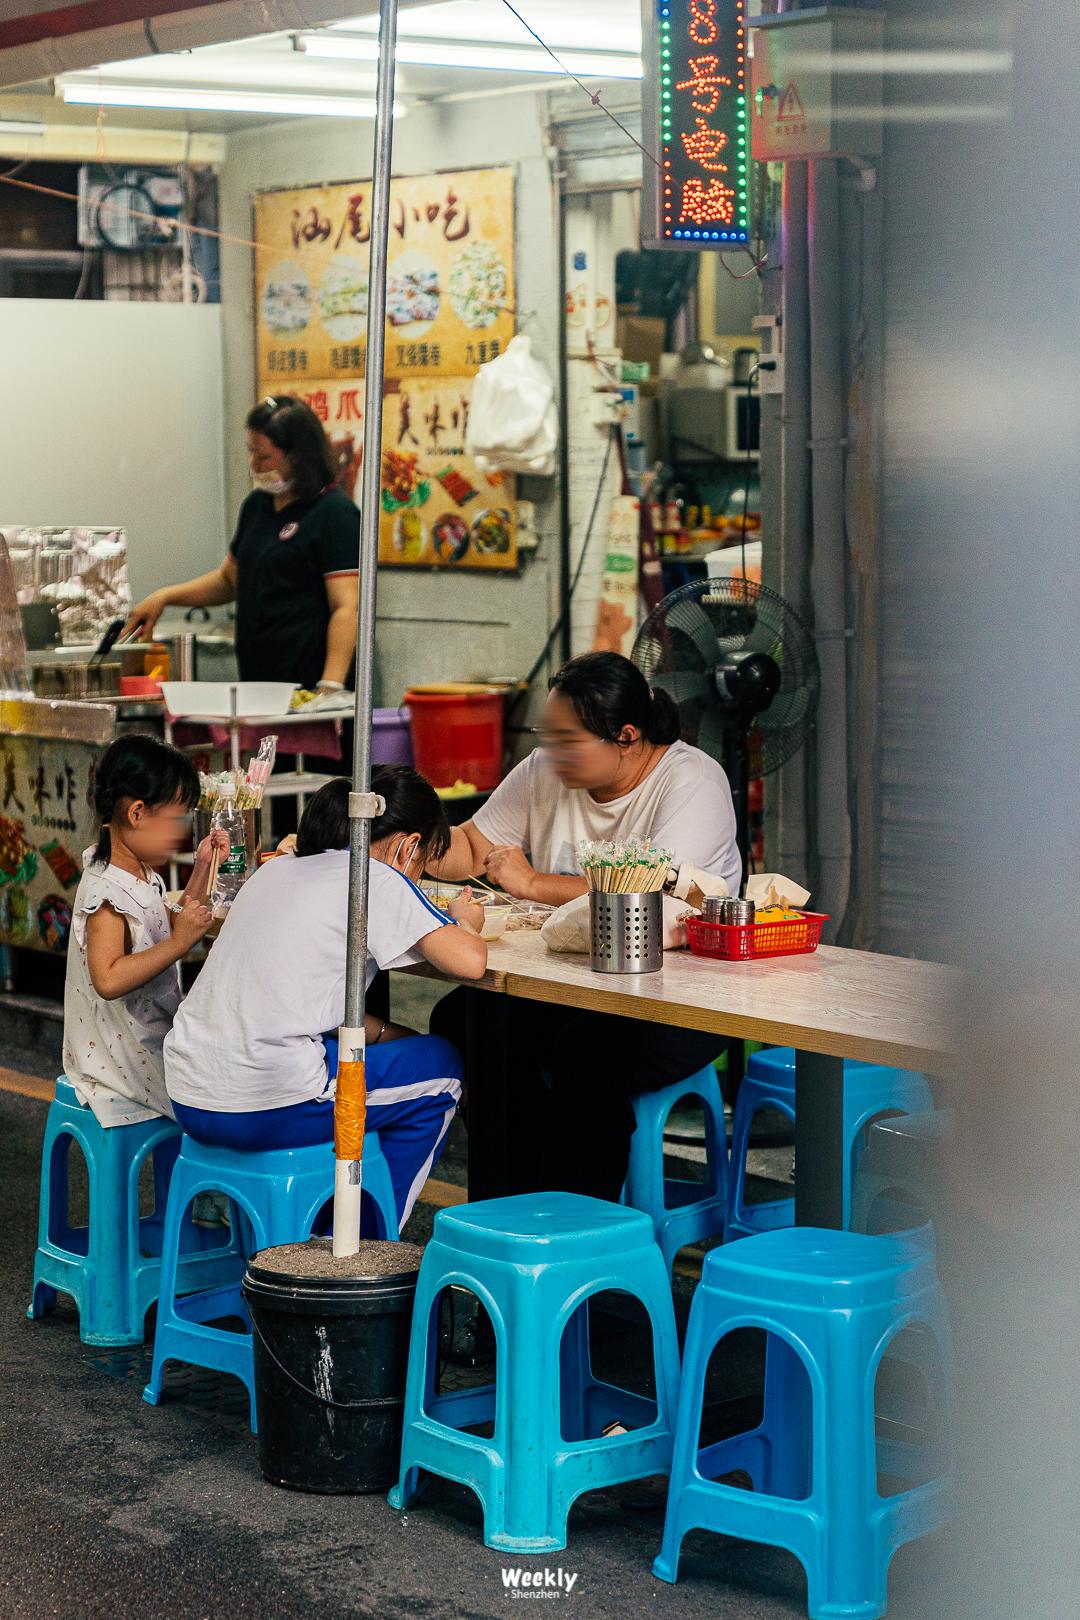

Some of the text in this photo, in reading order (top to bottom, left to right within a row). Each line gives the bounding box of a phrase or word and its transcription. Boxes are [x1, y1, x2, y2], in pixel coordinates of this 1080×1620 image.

[676, 0, 735, 224] 8号电脑
[276, 388, 362, 421] 鸡爪
